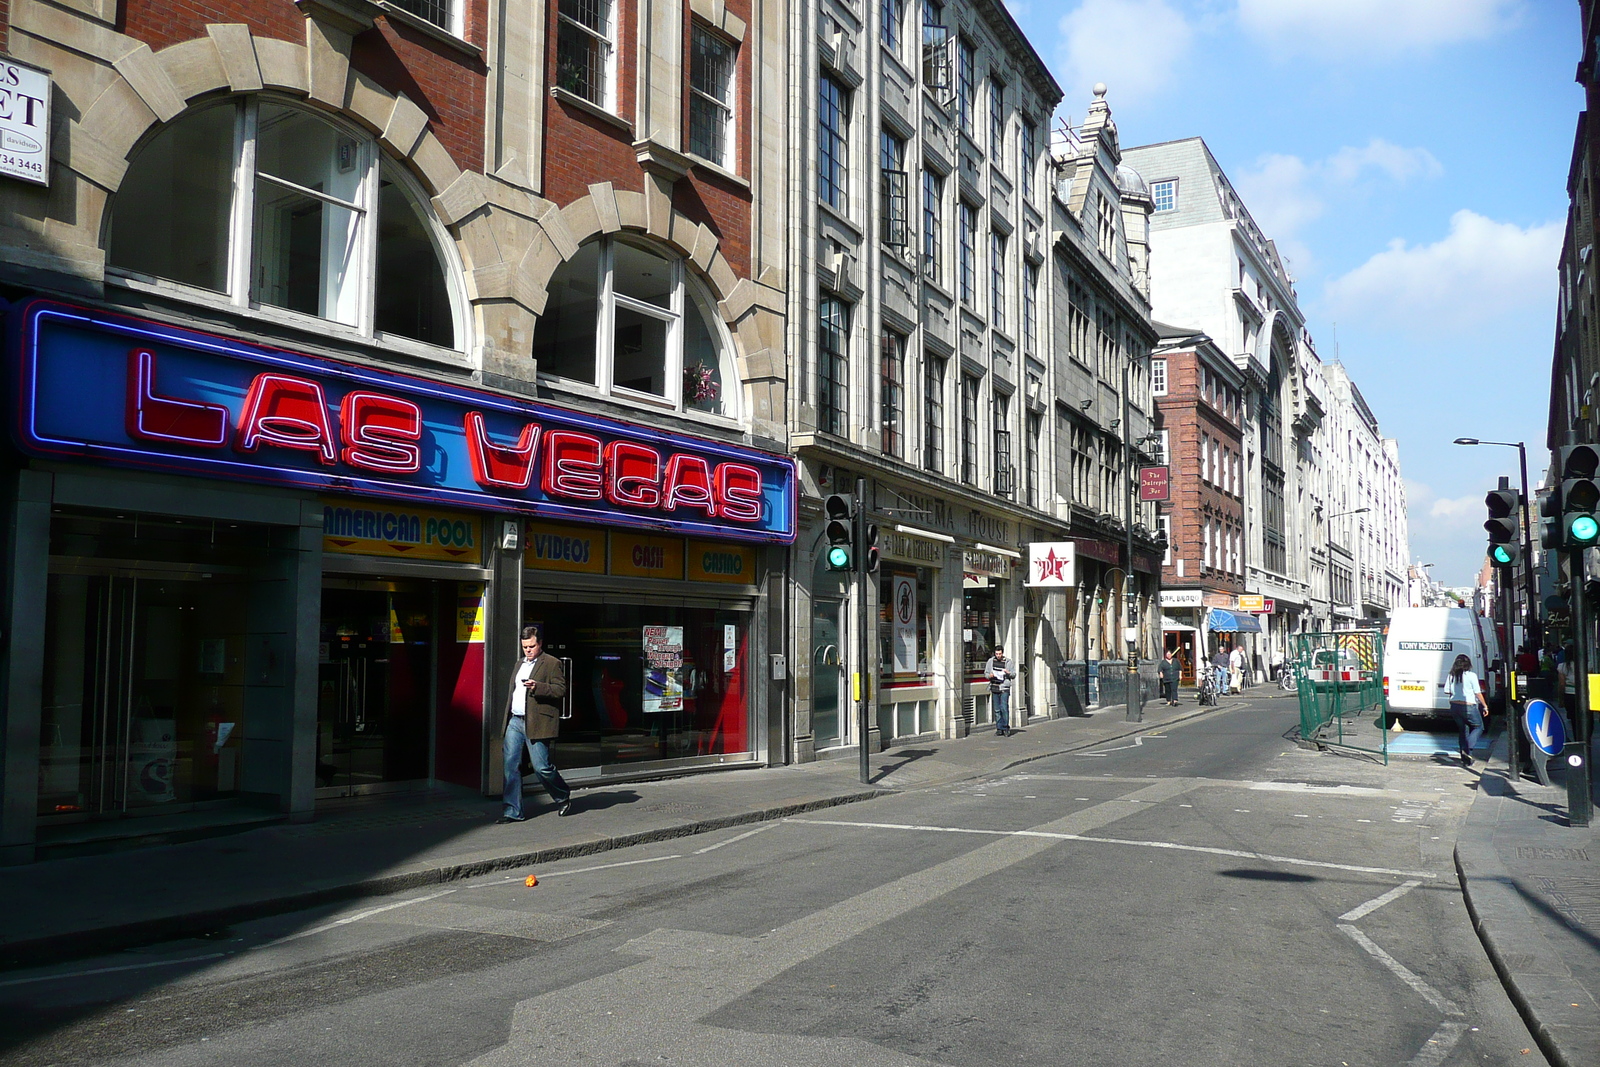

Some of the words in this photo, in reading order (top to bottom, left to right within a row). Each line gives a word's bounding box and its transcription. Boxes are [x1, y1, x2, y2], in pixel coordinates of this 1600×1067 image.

[6, 136, 38, 150] davidson
[0, 154, 15, 166] 34
[18, 158, 43, 173] 3443
[125, 348, 423, 475] LAS
[464, 411, 763, 523] VEGAS
[1148, 471, 1161, 479] The
[323, 505, 422, 545] AMERICAN
[425, 515, 475, 549] POOL
[896, 491, 955, 531] CINEMA
[968, 508, 1009, 544] HOUSE
[533, 533, 591, 564] VIDEOS
[631, 543, 665, 569] CASH
[702, 551, 743, 576] CASINO
[1036, 556, 1067, 577] PRET
[459, 610, 477, 619] Cash
[1400, 642, 1418, 650] TONY
[1418, 642, 1452, 651] McFADDEN
